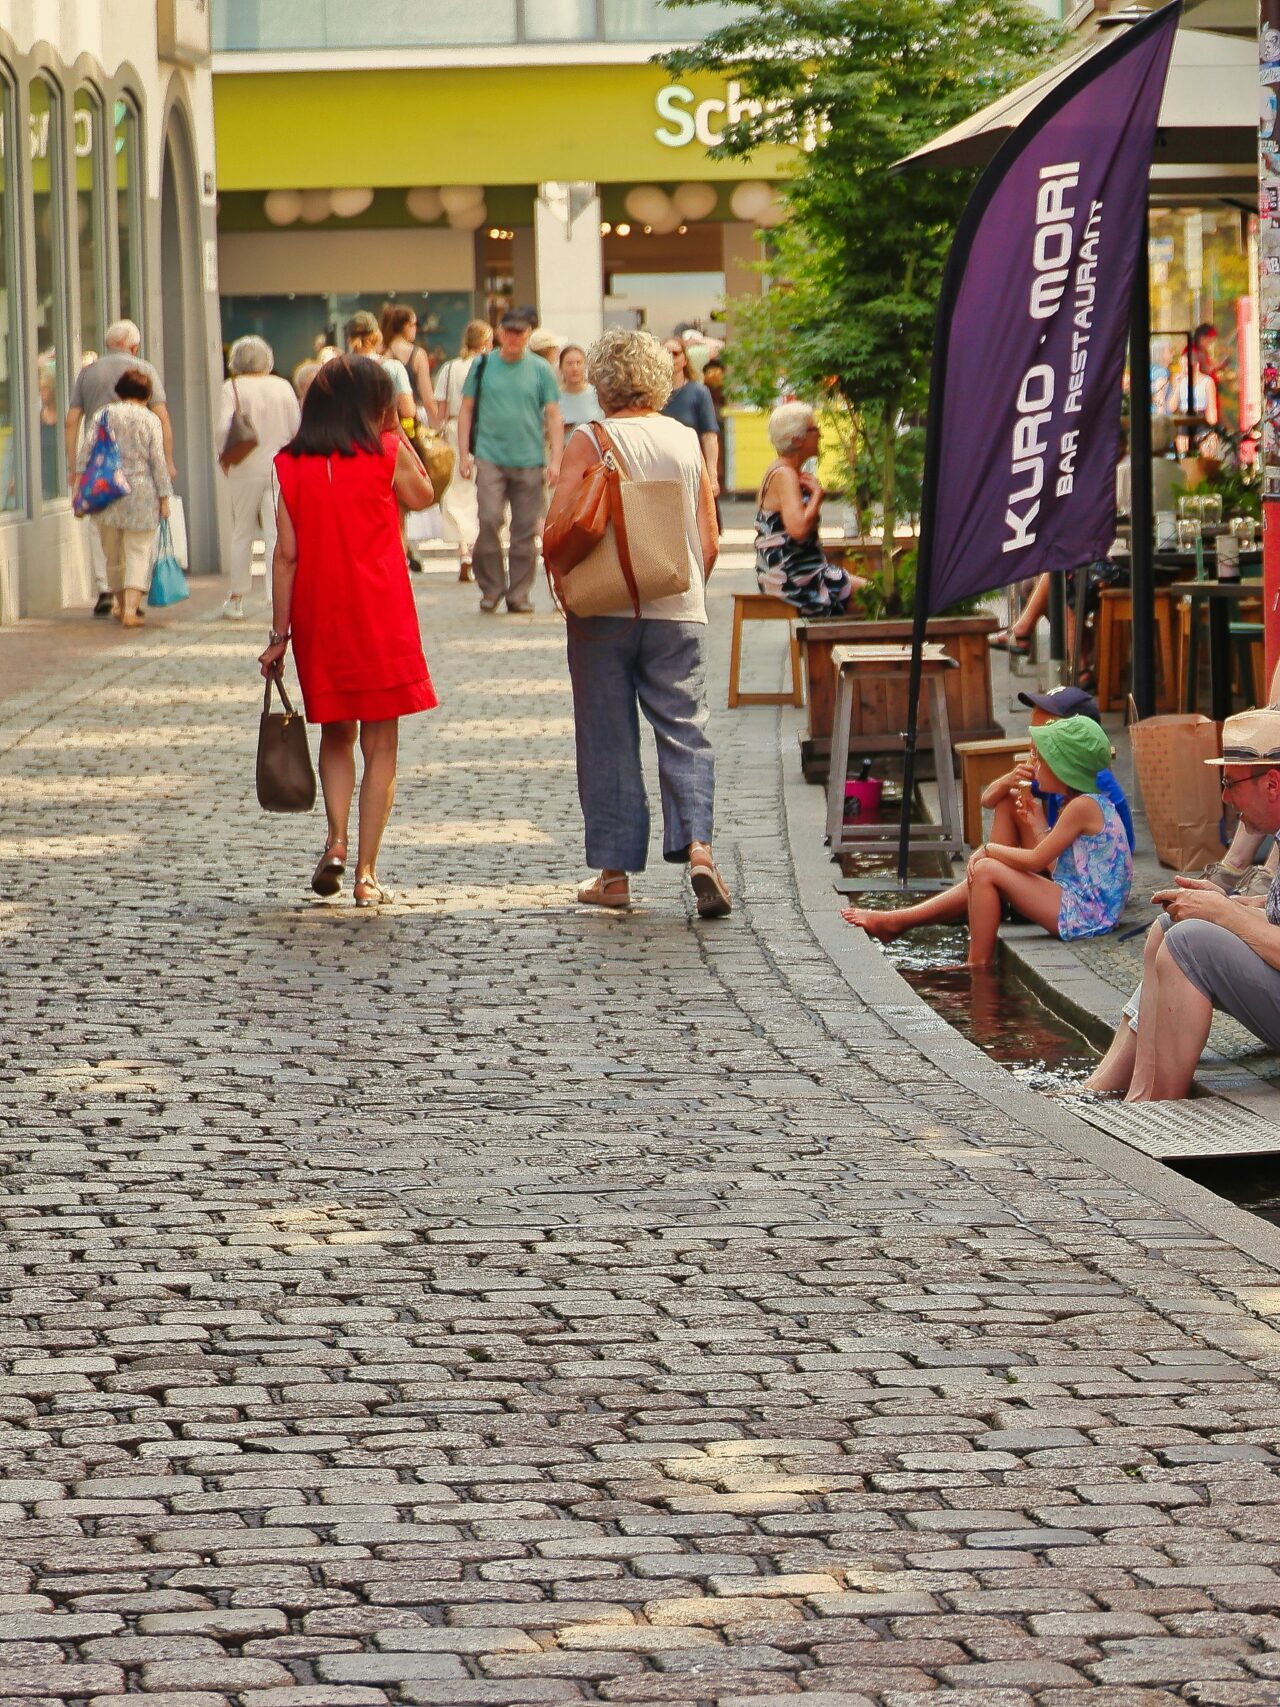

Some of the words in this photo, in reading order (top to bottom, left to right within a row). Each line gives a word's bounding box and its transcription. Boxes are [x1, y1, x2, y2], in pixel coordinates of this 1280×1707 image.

[1002, 363, 1055, 553] KURO
[1029, 161, 1080, 319] MORI
[1064, 200, 1103, 414] RESTAURANT
[1056, 429, 1079, 498] BAR
